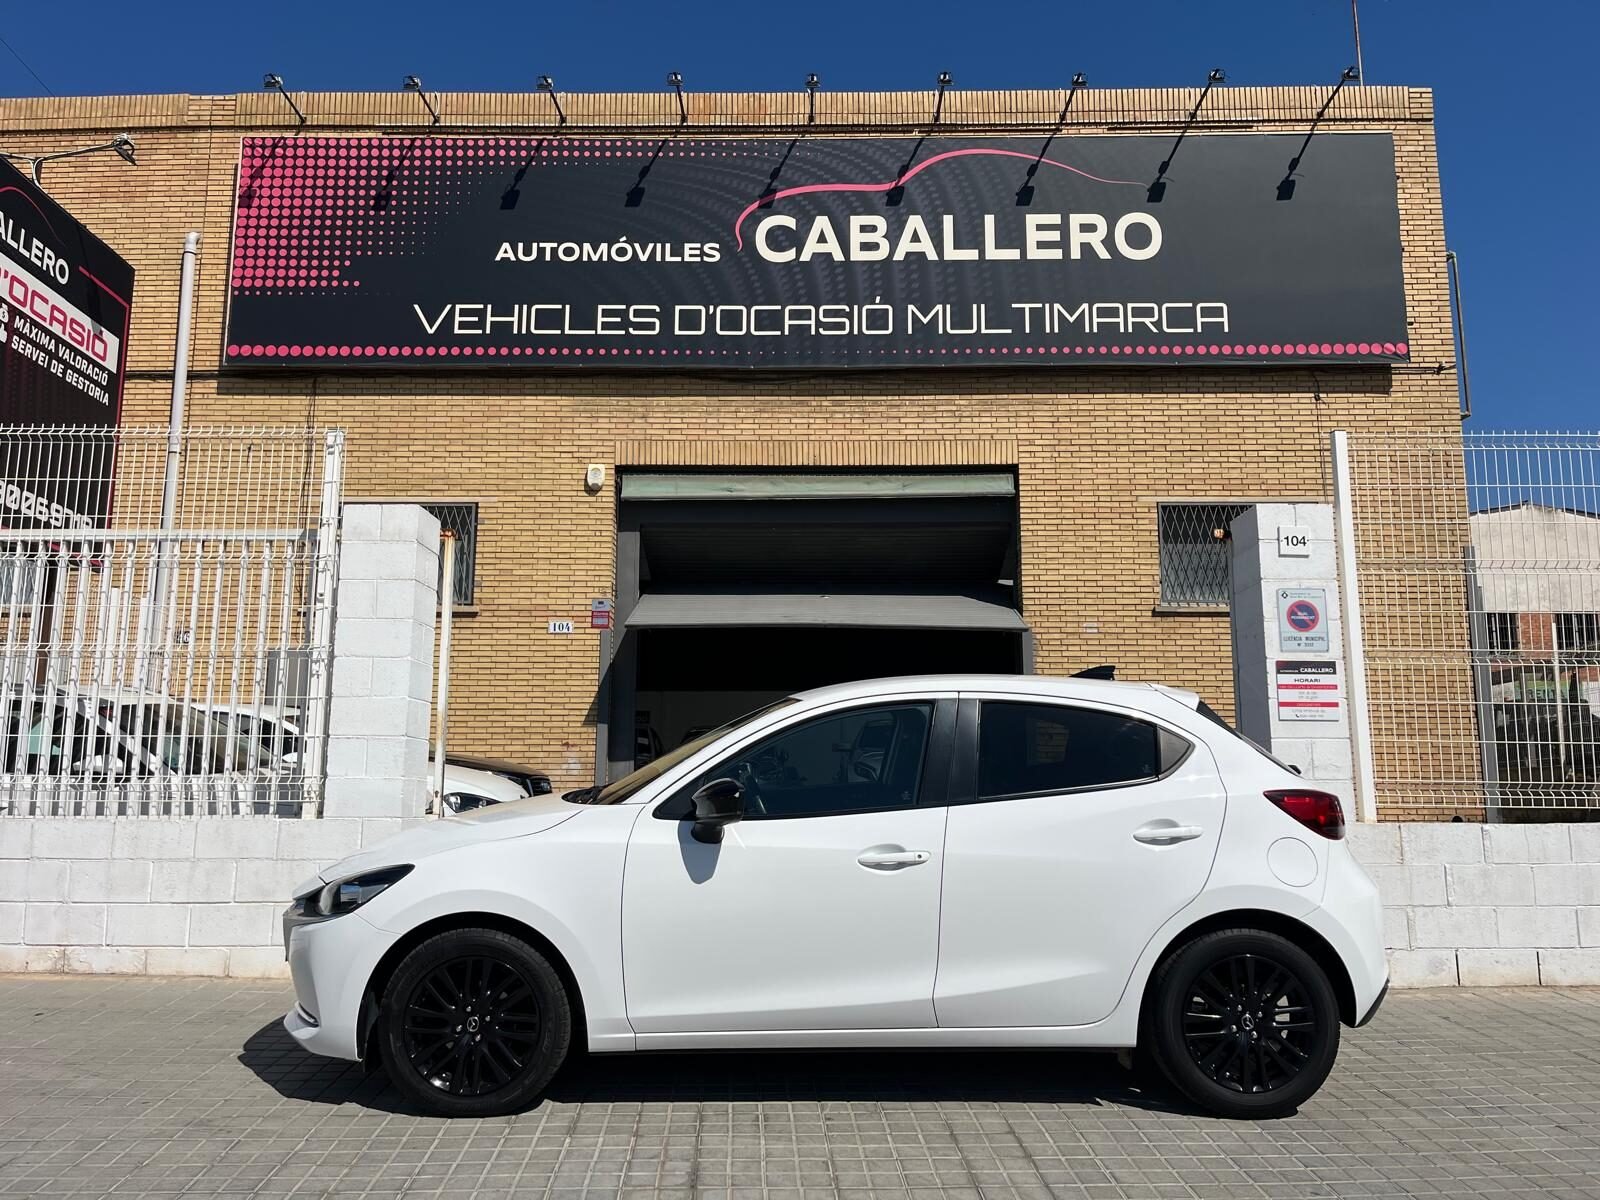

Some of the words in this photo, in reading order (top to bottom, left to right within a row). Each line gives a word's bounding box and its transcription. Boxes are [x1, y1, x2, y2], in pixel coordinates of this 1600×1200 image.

[495, 236, 721, 262] AUTOMÓVILES
[755, 212, 1163, 263] CABALLERO
[0, 268, 109, 363] 'OCASIÓ
[413, 303, 661, 335] VEHICLES
[674, 296, 894, 336] D'OCASIÓ
[907, 302, 1229, 335] MULTIMARCA
[11, 336, 49, 368] SERVEI
[50, 359, 64, 378] DE
[65, 368, 110, 406] GESTORIA
[14, 315, 56, 353] MÀXIMA
[58, 343, 109, 386] VALORACIÓ
[1283, 535, 1307, 547] 104
[553, 622, 570, 632] 104
